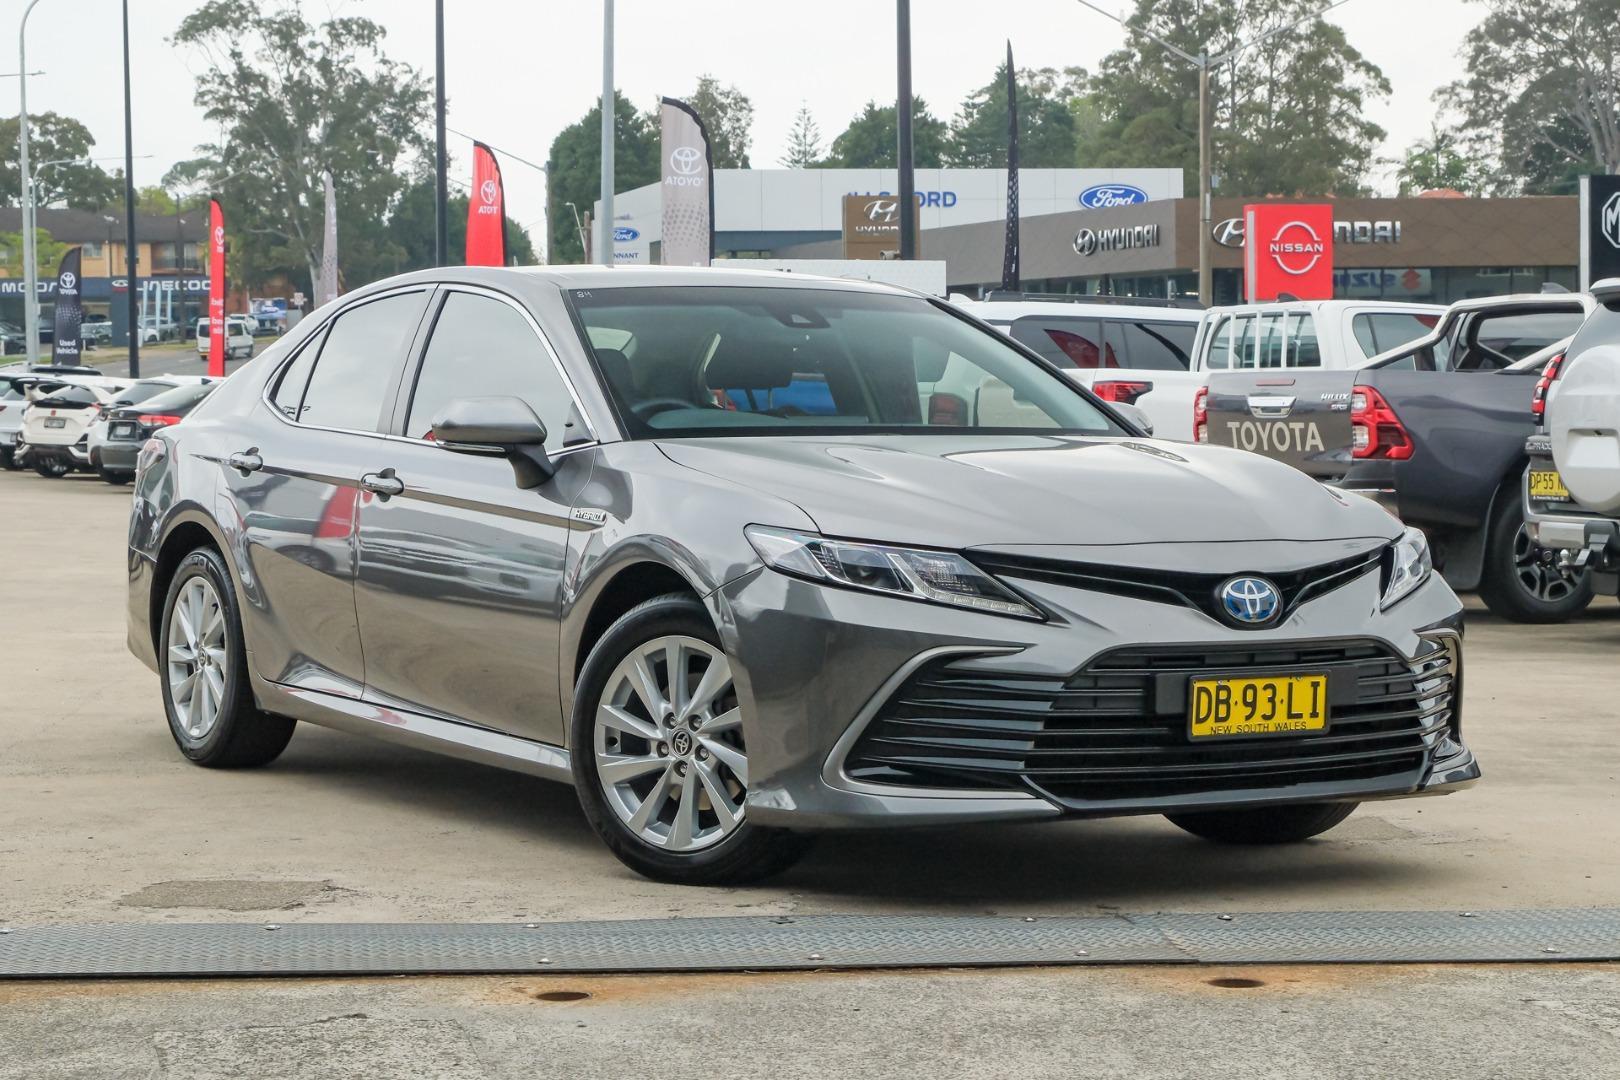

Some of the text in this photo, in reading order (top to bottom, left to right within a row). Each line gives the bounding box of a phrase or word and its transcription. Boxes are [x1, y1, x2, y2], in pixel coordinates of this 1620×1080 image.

[1092, 188, 1136, 208] Ford
[1333, 220, 1401, 243] NDAI
[1606, 197, 1620, 243] M
[1098, 224, 1160, 251] HYUNDAI
[1269, 243, 1324, 252] NISSAN
[1226, 420, 1326, 453] TOYOTA
[1210, 721, 1308, 735] NEW SOUTH WALES
